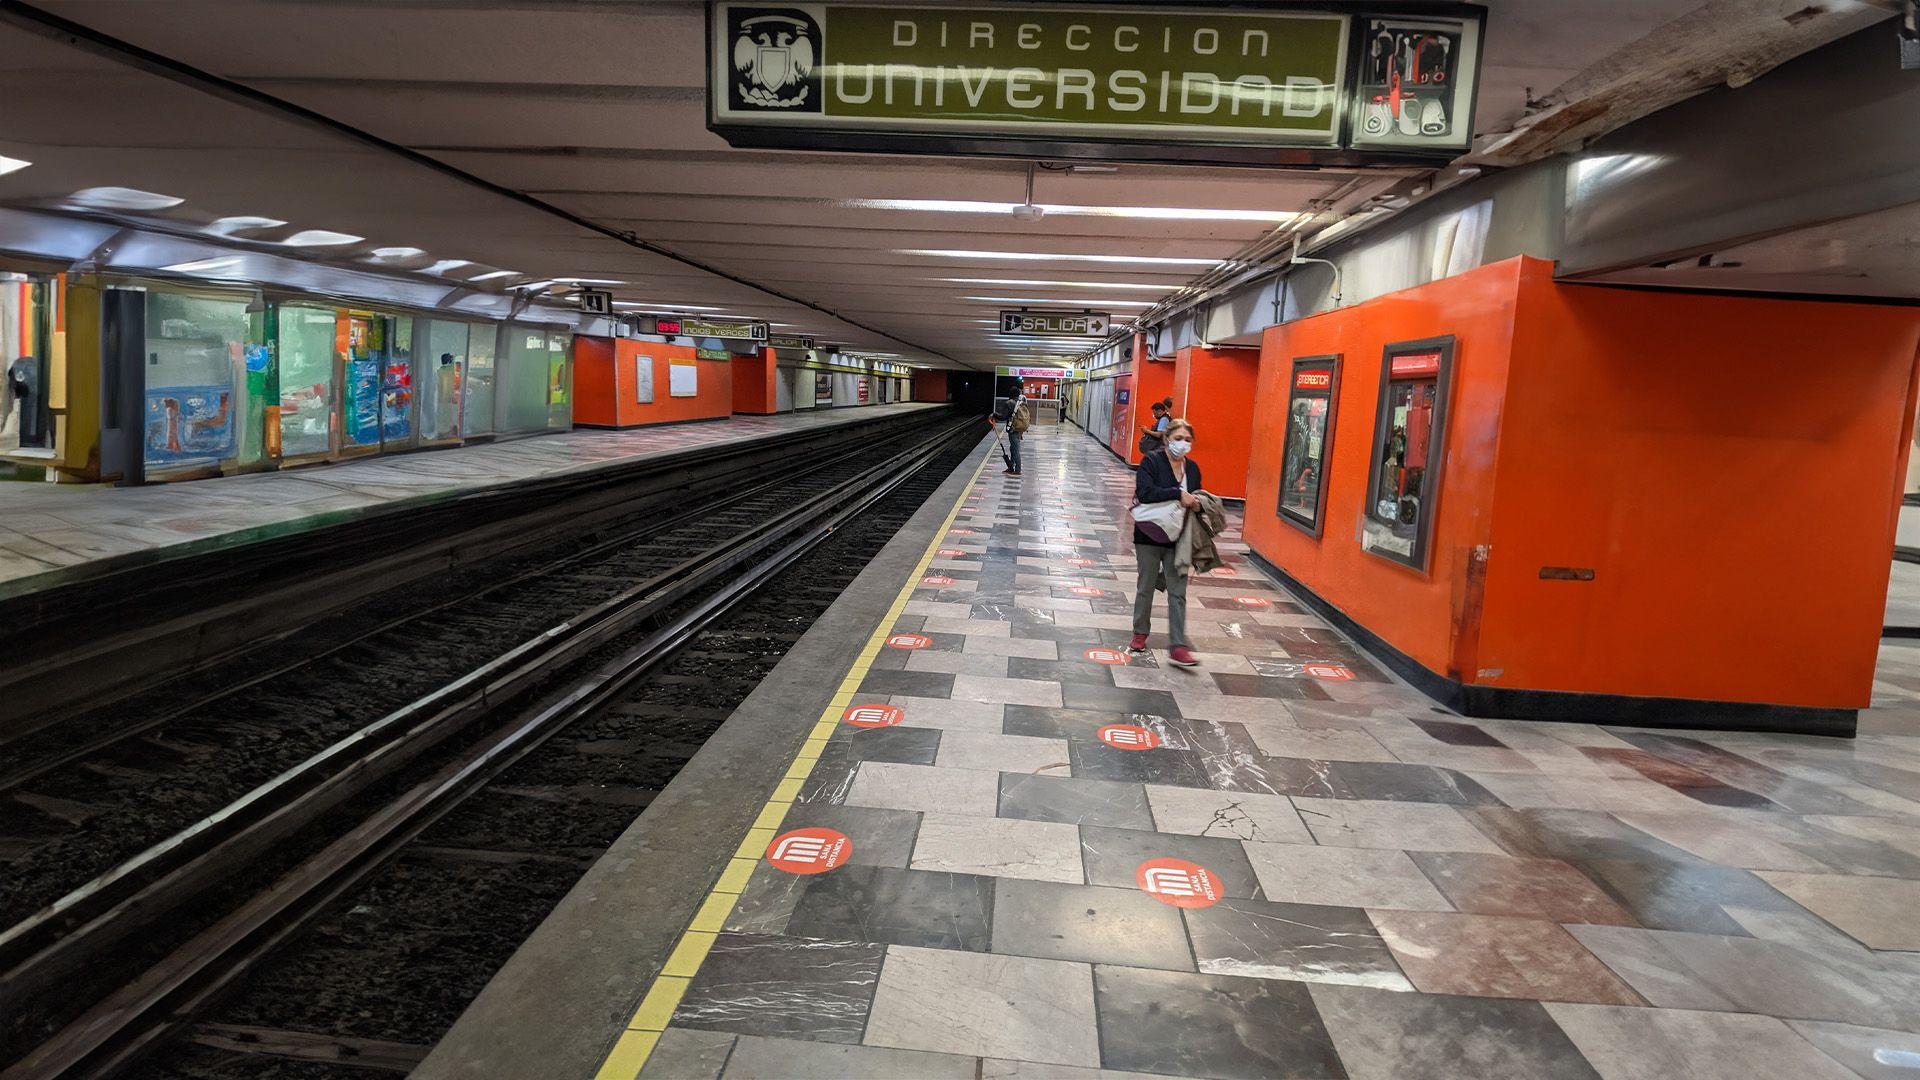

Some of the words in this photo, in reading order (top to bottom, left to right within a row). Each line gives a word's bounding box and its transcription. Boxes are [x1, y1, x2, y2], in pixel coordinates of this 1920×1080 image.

[893, 20, 1268, 57] DIRECCION
[836, 62, 1324, 118] UNIVERSIDAD
[684, 327, 711, 335] INDIOS
[714, 329, 749, 337] VERDES
[1022, 318, 1087, 332] SALIDA
[825, 837, 847, 868] DISTANCIA
[1197, 868, 1217, 901] DISTANCIA
